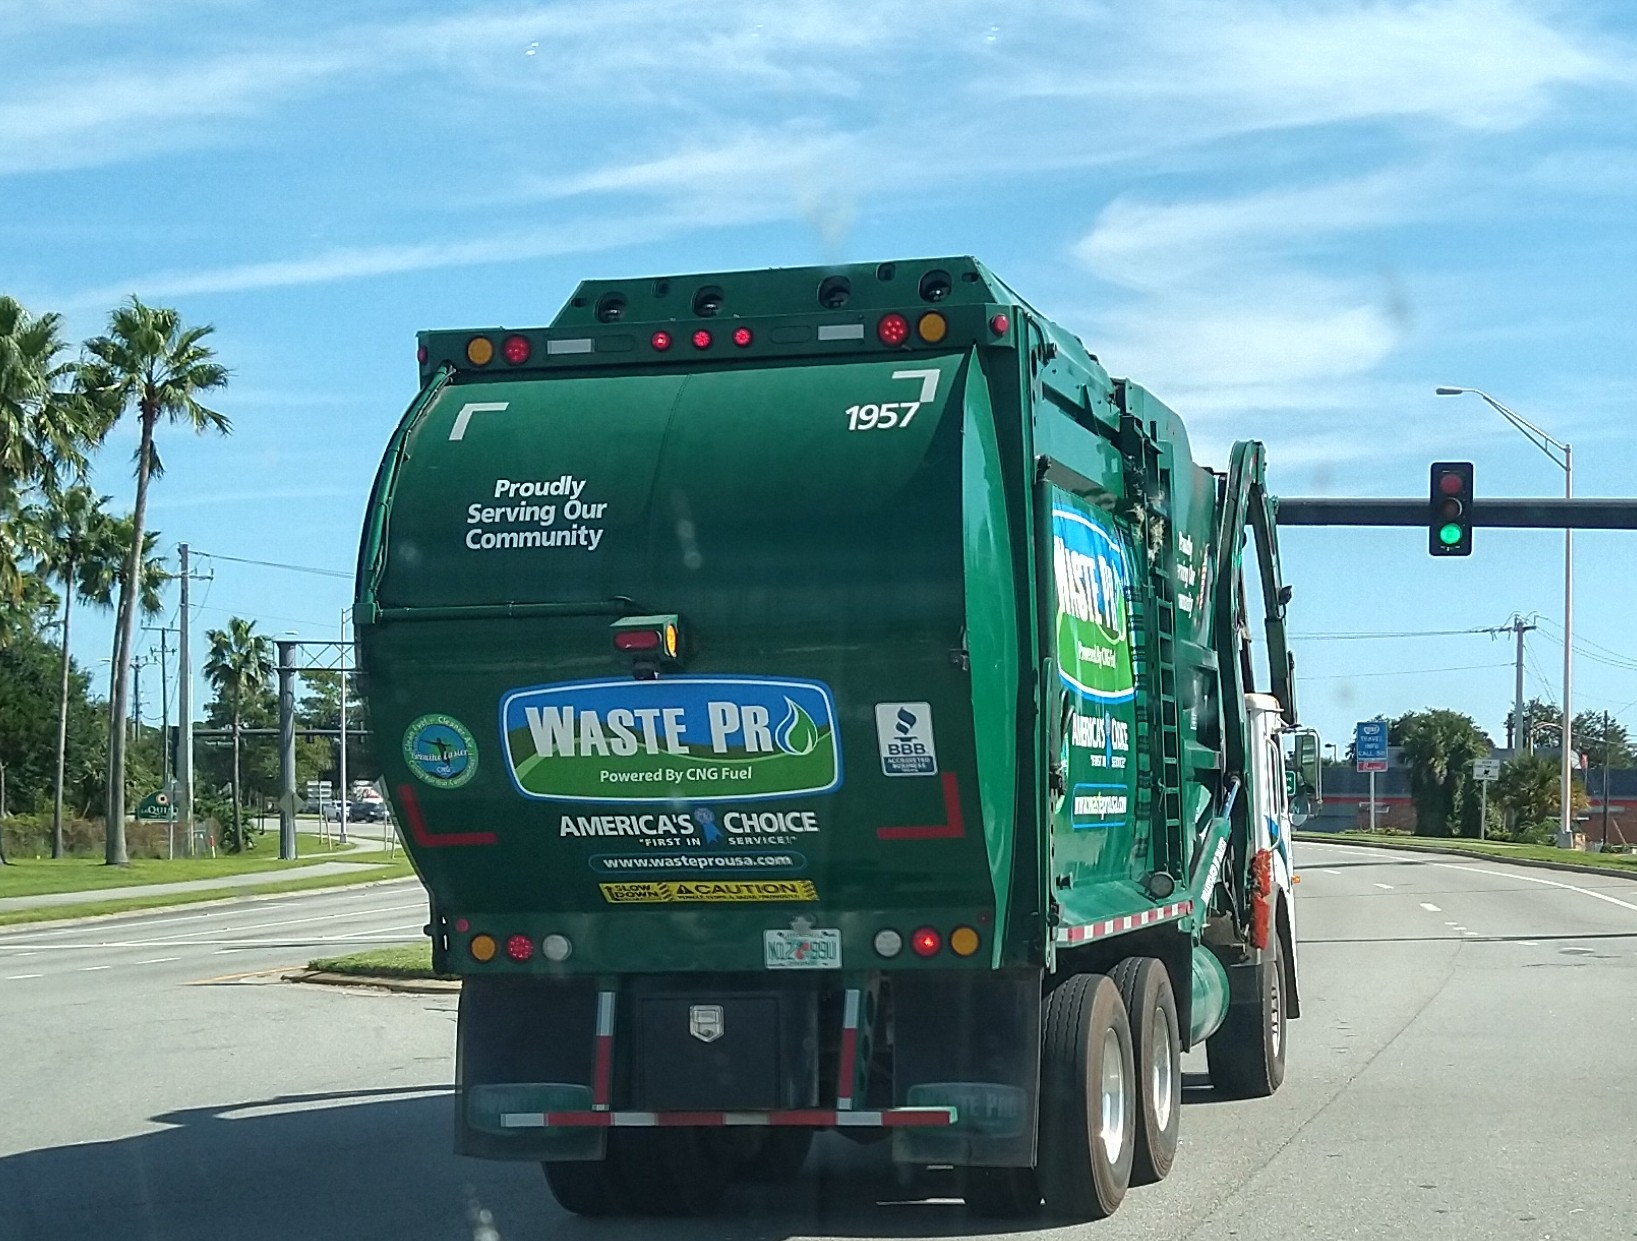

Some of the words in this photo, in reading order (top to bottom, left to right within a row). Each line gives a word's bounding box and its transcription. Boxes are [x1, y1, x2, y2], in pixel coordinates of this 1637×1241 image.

[845, 402, 920, 431] 1957
[494, 475, 587, 500] Proudly
[466, 501, 557, 527] Serving
[563, 500, 608, 521] Our
[465, 523, 604, 551] Community
[525, 705, 690, 758] WASTE
[888, 743, 926, 755] BBB
[600, 768, 662, 783] Powered
[665, 768, 683, 784] By
[686, 767, 718, 781] CNG
[722, 766, 752, 779] Fuel
[560, 813, 694, 837] AMERICA'S
[723, 811, 820, 834] CHOICE
[686, 837, 701, 846] IN
[603, 855, 794, 869] www.wasteprousa.com
[614, 884, 651, 892] SLOW
[694, 884, 799, 895] CAUTION
